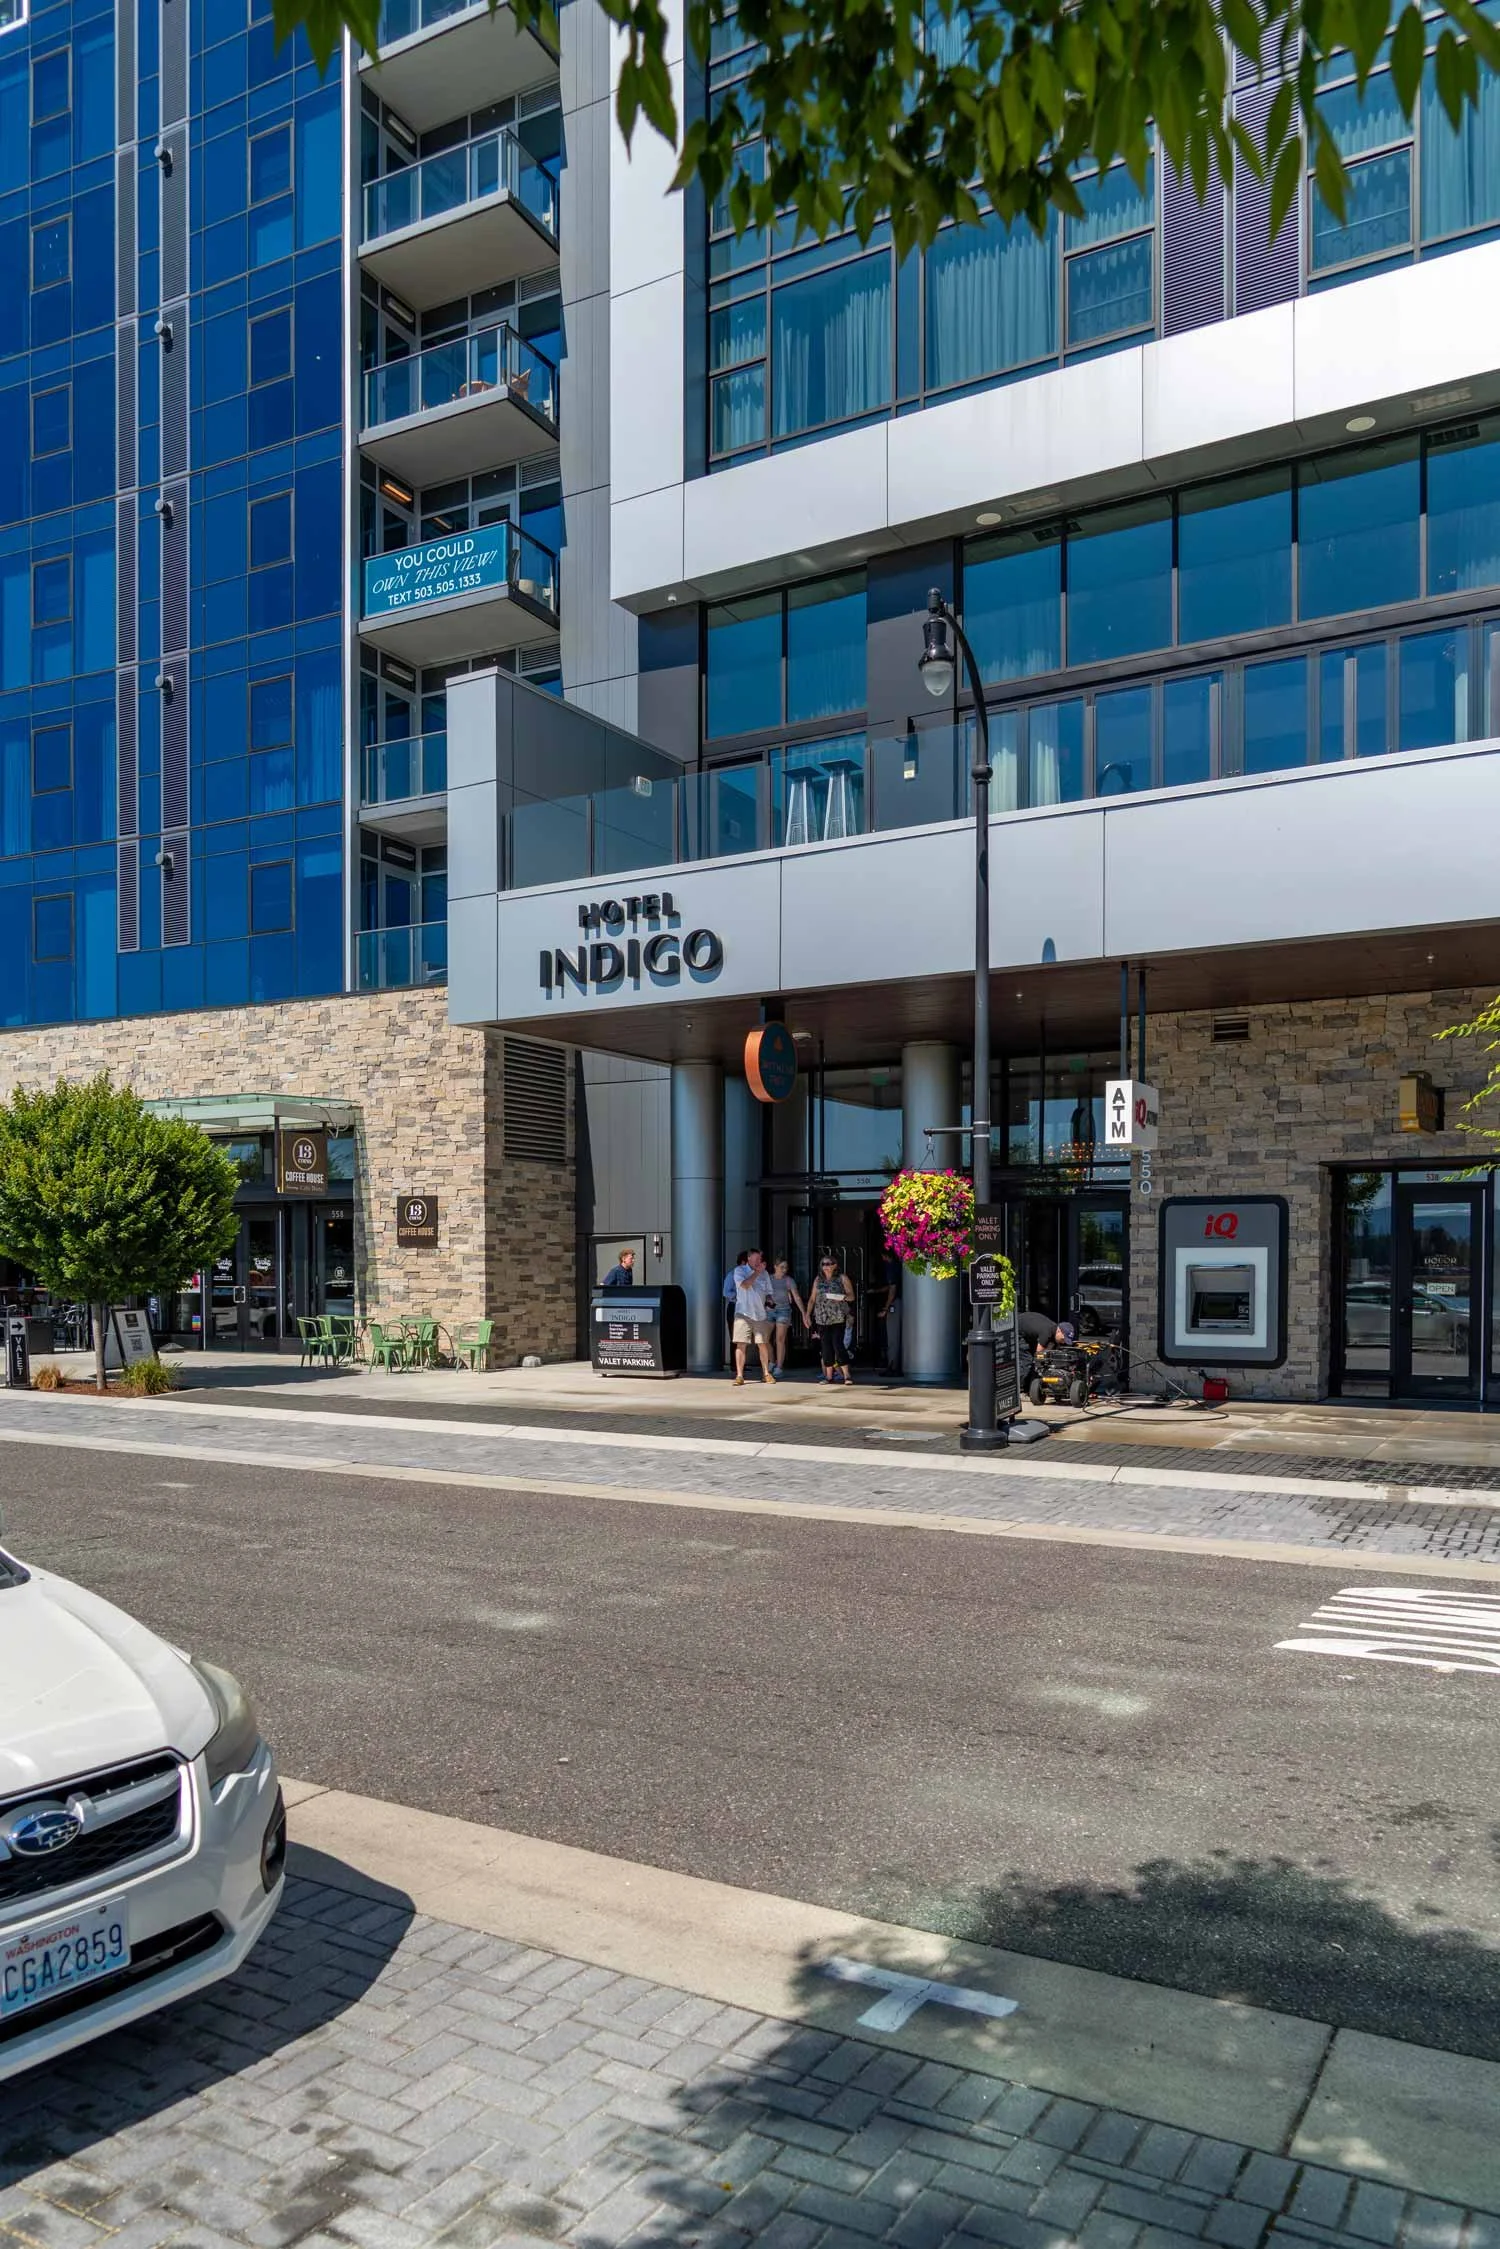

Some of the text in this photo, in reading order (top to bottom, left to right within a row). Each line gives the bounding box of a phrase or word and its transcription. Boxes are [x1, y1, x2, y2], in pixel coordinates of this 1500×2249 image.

[395, 539, 475, 572] YOU COULD
[372, 549, 498, 594] OWN THIS VIEW!
[387, 573, 481, 606] TEXT 503.505.1333
[578, 892, 681, 929] HOTEL
[539, 928, 724, 988] INDIGO
[1111, 1087, 1126, 1138] ATM
[298, 1144, 312, 1159] 13
[285, 1170, 325, 1184] COFFEE HOUSE
[1140, 1150, 1152, 1194] 550
[409, 1204, 422, 1216] 13
[977, 1216, 998, 1225] VALET
[1203, 1211, 1240, 1240] iQ
[398, 1227, 417, 1236] COFFEE
[974, 1225, 1001, 1233] PARKING
[978, 1232, 998, 1241] ONLY
[976, 1272, 999, 1280] PARKING
[980, 1265, 996, 1273] VALET
[1428, 1284, 1455, 1294] OPEN
[15, 1336, 24, 1376] VALET
[598, 1357, 656, 1367] VALET PARKING
[998, 1396, 1013, 1410] VALET
[5, 1924, 80, 1960] WASHINGTON
[4, 1923, 123, 2002] CGA2859
